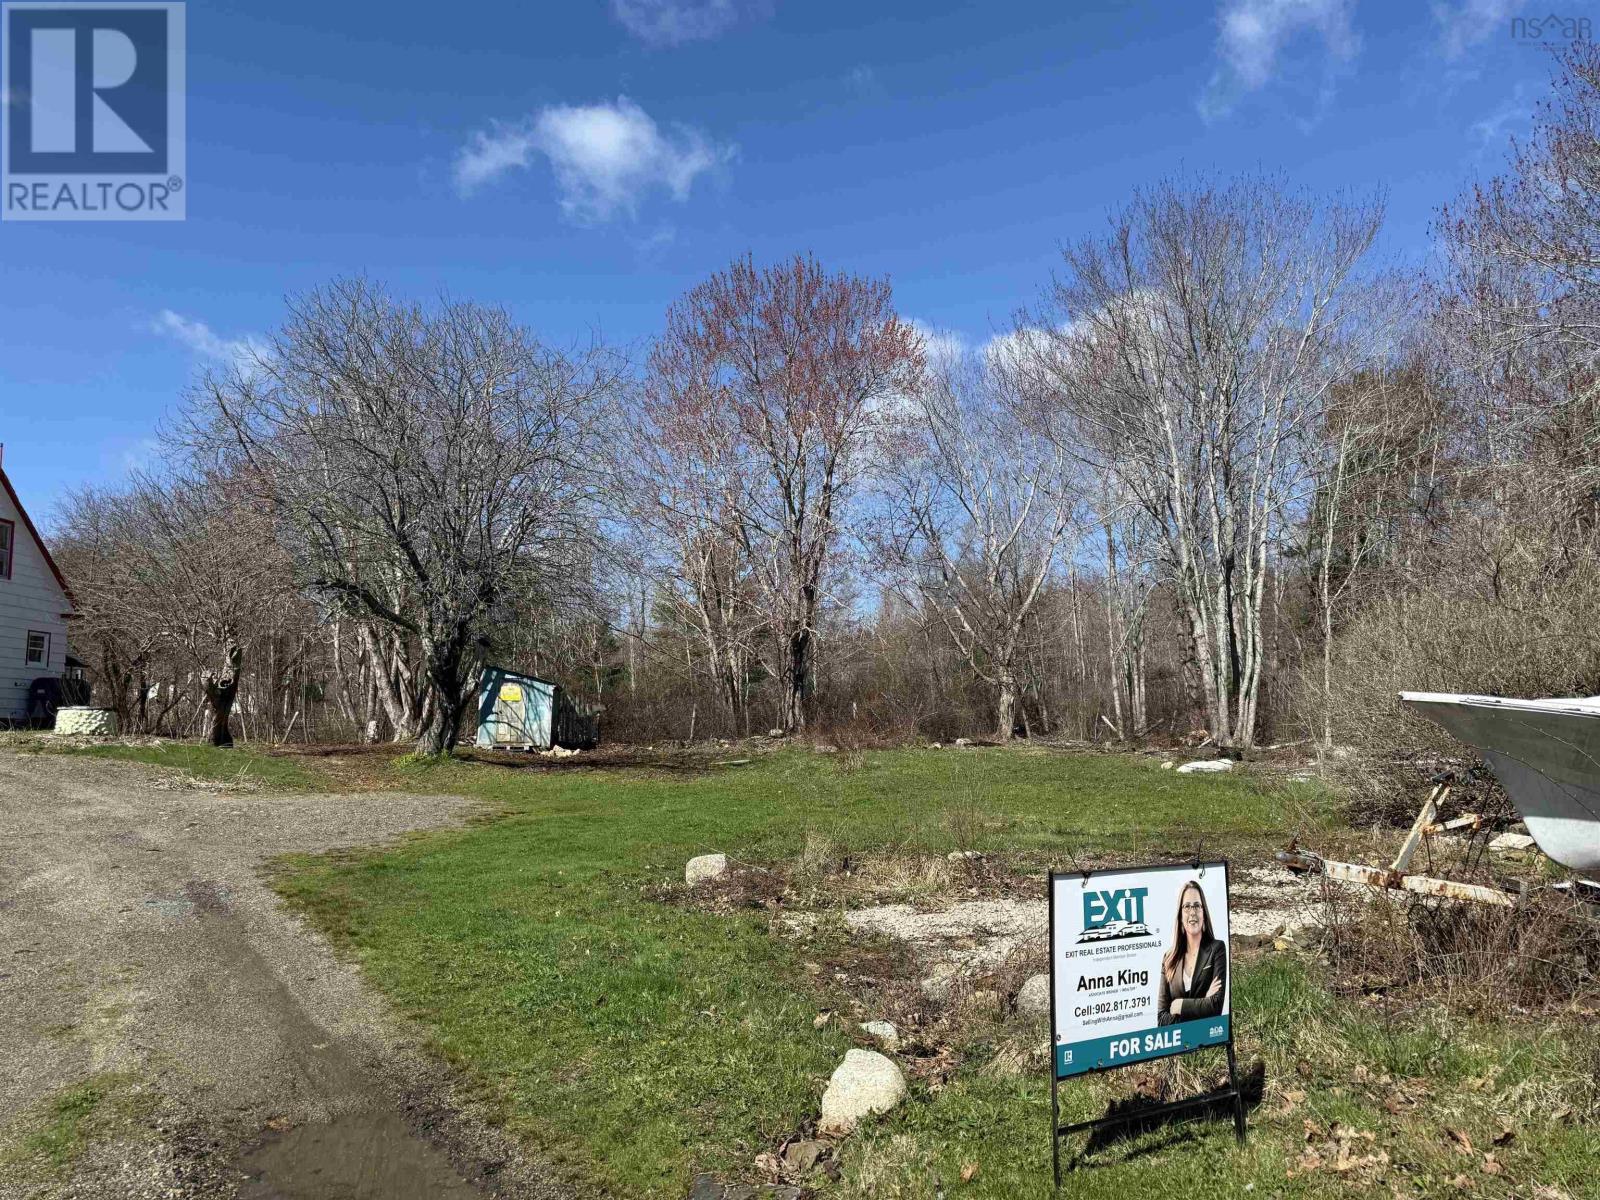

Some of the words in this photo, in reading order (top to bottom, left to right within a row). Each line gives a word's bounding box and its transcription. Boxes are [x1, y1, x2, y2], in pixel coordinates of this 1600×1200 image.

[1065, 951, 1078, 959] EXIT
[1079, 949, 1094, 957] REAL
[1095, 946, 1116, 955] ESTATE
[1117, 940, 1162, 952] PROFESSIONALS
[1077, 975, 1113, 992] Anna
[1117, 969, 1149, 986] King
[1074, 996, 1151, 1018] Cell:902.817.3791
[1109, 1035, 1141, 1060] FOR
[1144, 1029, 1182, 1052] SALE
